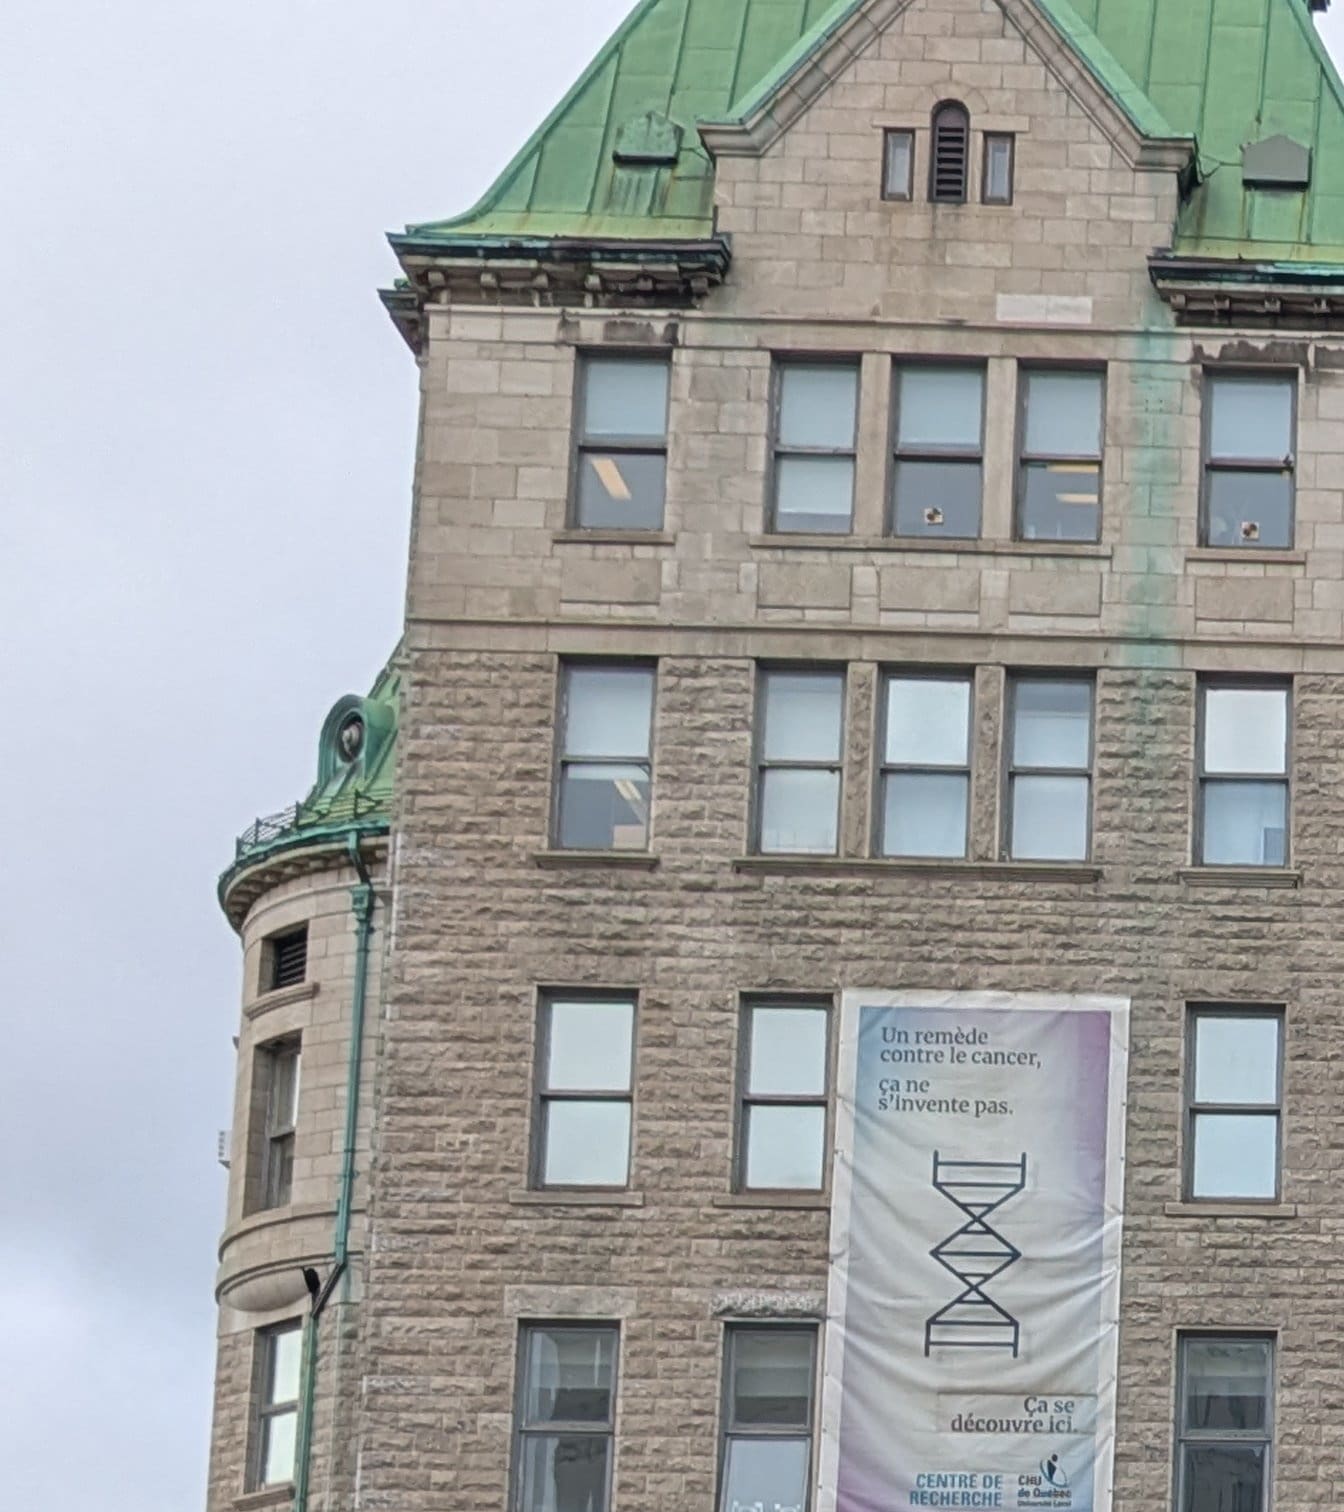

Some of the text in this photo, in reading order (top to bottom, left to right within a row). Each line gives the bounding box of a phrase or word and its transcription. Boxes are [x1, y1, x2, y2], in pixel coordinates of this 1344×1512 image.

[882, 1027, 988, 1045] Un remède
[880, 1047, 1041, 1069] contre le cancer,
[879, 1079, 930, 1096] ça ne
[878, 1094, 1013, 1117] s'invente pas.
[1024, 1396, 1075, 1417] Ça se
[951, 1412, 1078, 1433] découvre ici.
[916, 1473, 1003, 1489] CENTRE DE
[1018, 1475, 1042, 1486] CHU
[909, 1491, 1003, 1506] RECHERCHE
[1018, 1488, 1072, 1499] de Québec
